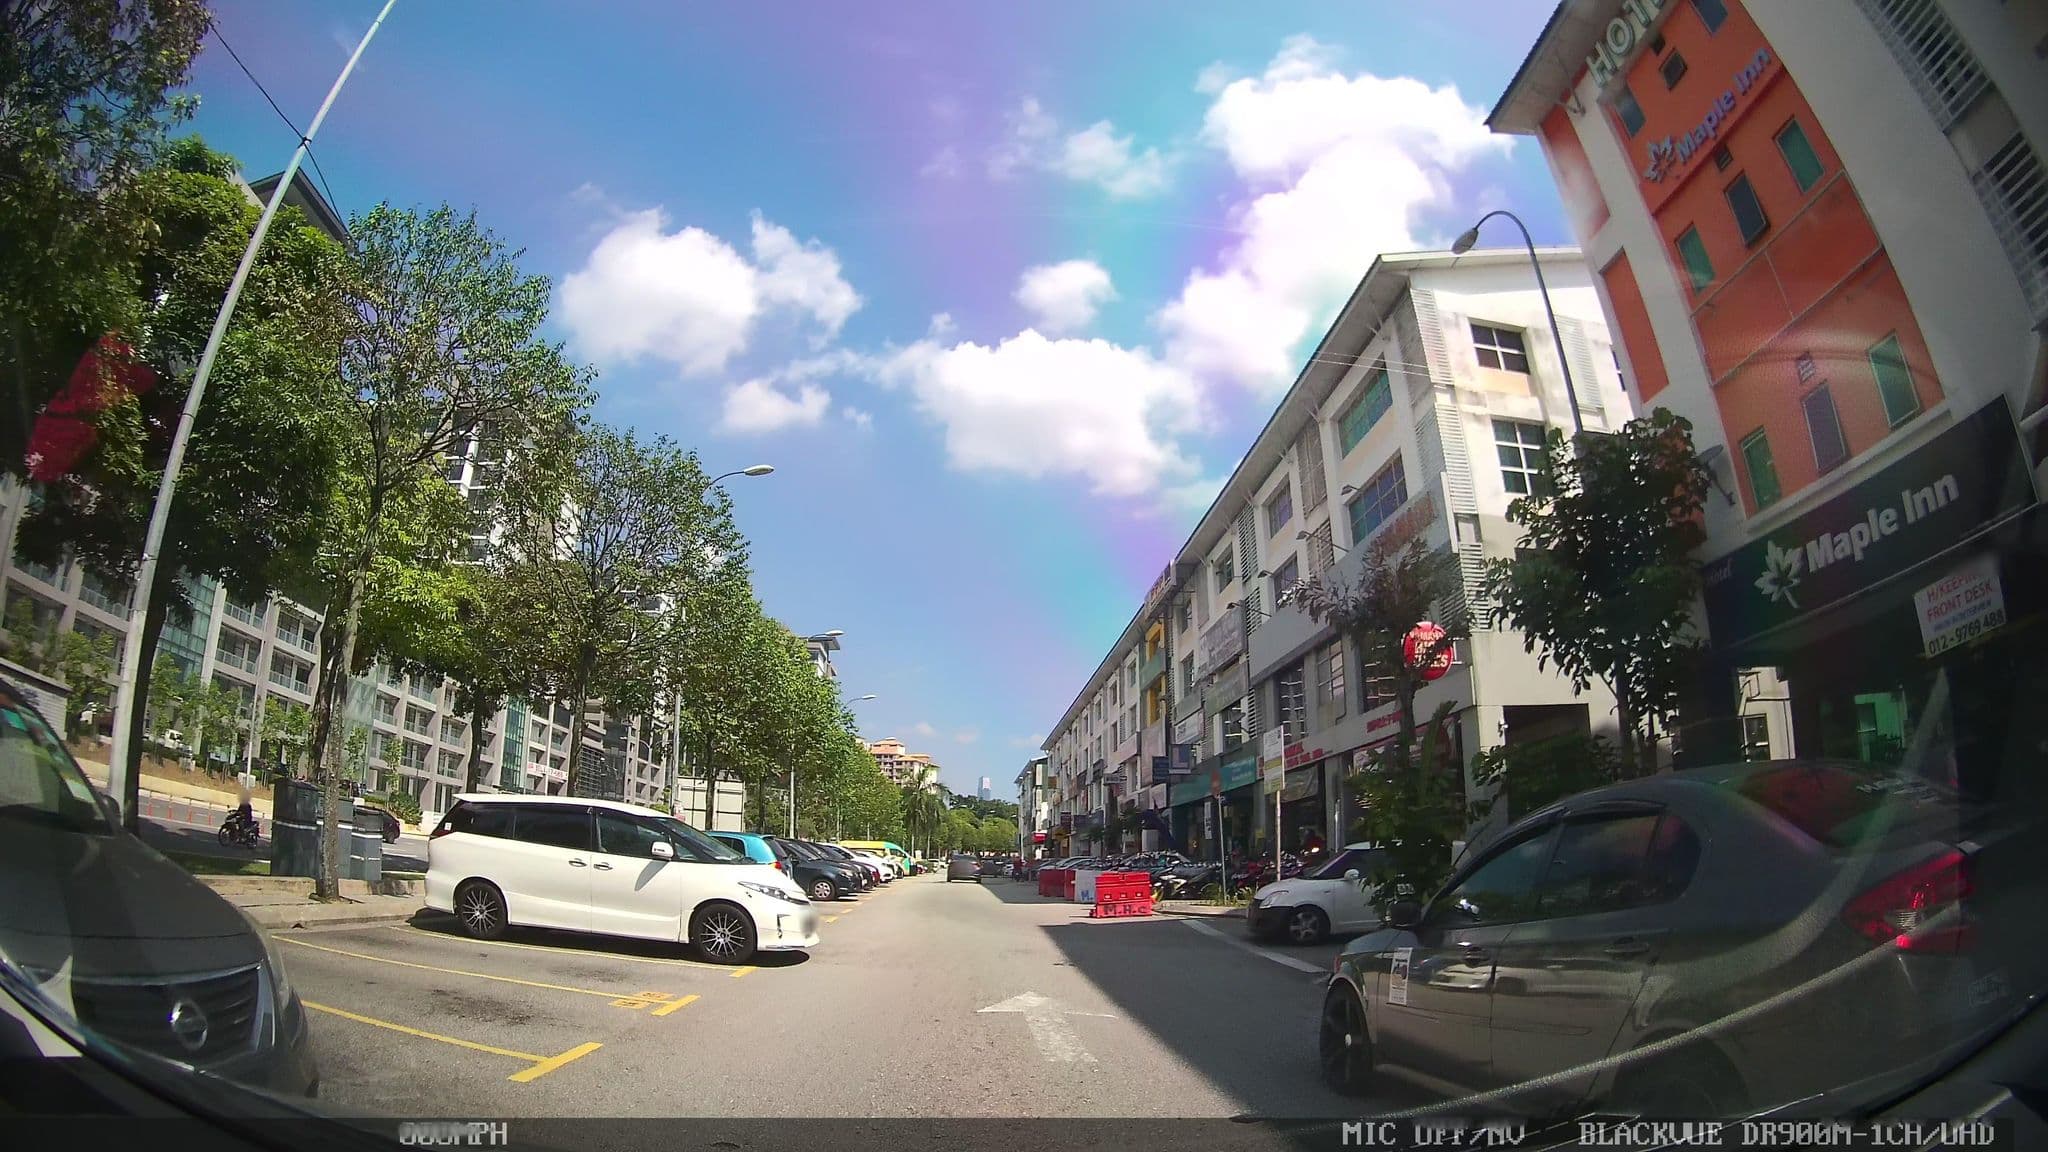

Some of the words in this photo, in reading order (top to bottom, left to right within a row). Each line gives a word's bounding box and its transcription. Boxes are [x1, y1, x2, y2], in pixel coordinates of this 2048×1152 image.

[1675, 90, 1736, 164] Maple
[1733, 48, 1771, 96] Inn
[1806, 508, 1899, 573] Maple
[1901, 474, 1959, 525] Inn
[1926, 594, 1962, 622] FRONT
[1964, 579, 1993, 604] DESK
